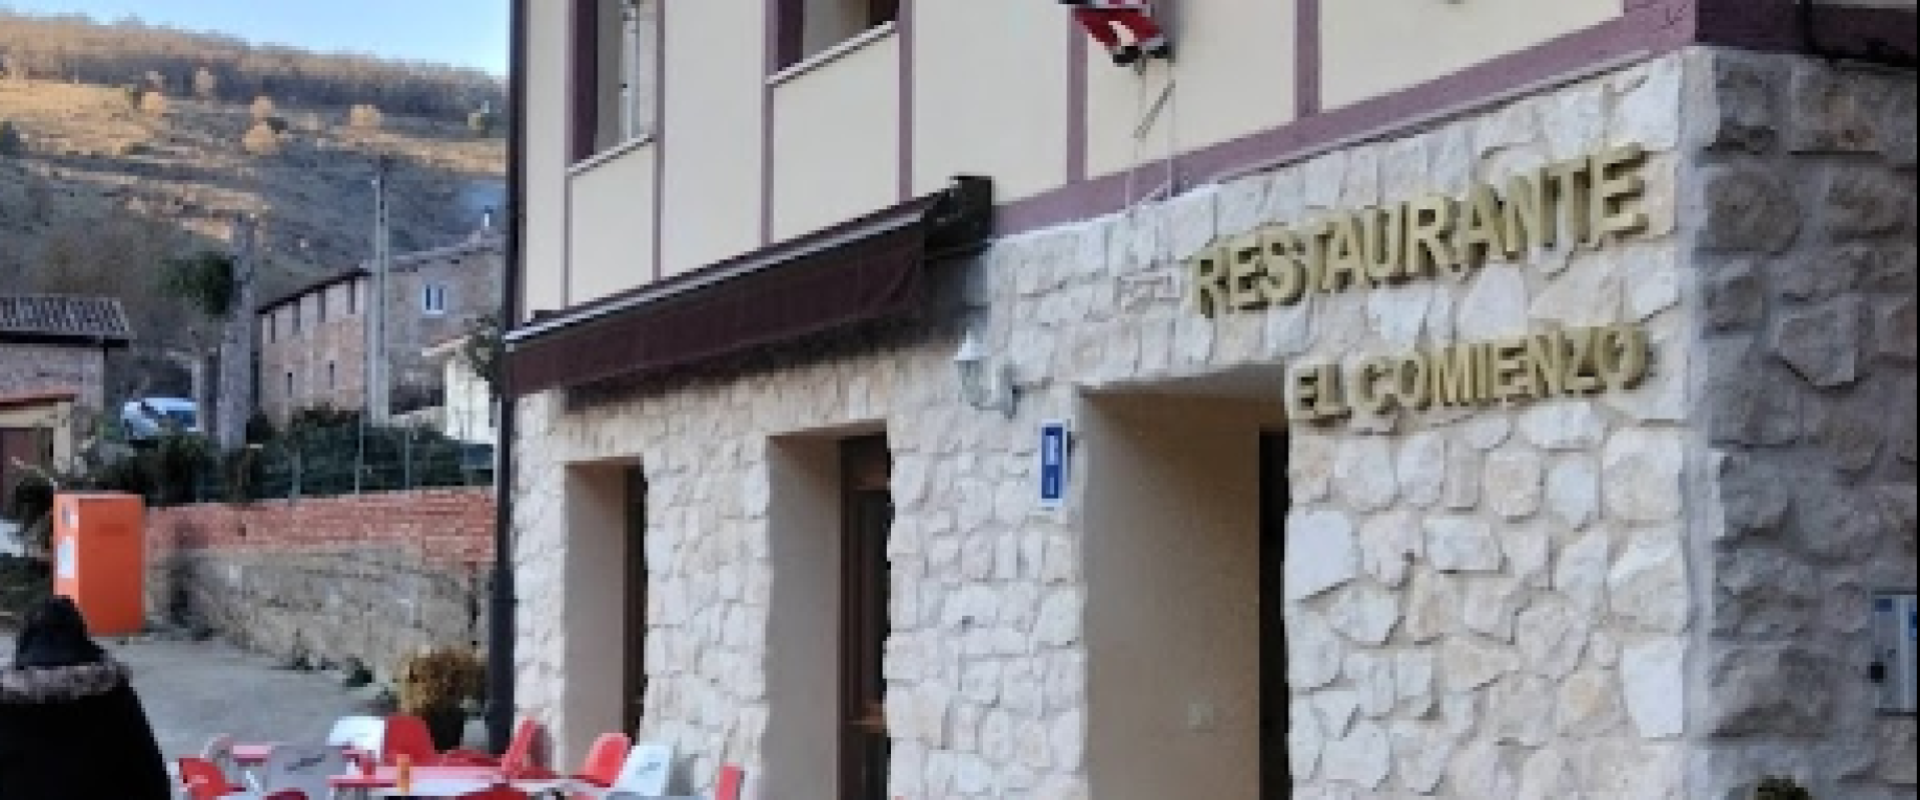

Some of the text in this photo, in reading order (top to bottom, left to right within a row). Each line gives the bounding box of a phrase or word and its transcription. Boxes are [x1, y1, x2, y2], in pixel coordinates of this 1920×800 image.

[1186, 142, 1650, 316] RESTAURANTE
[1291, 321, 1652, 423] EL COMIENZO
